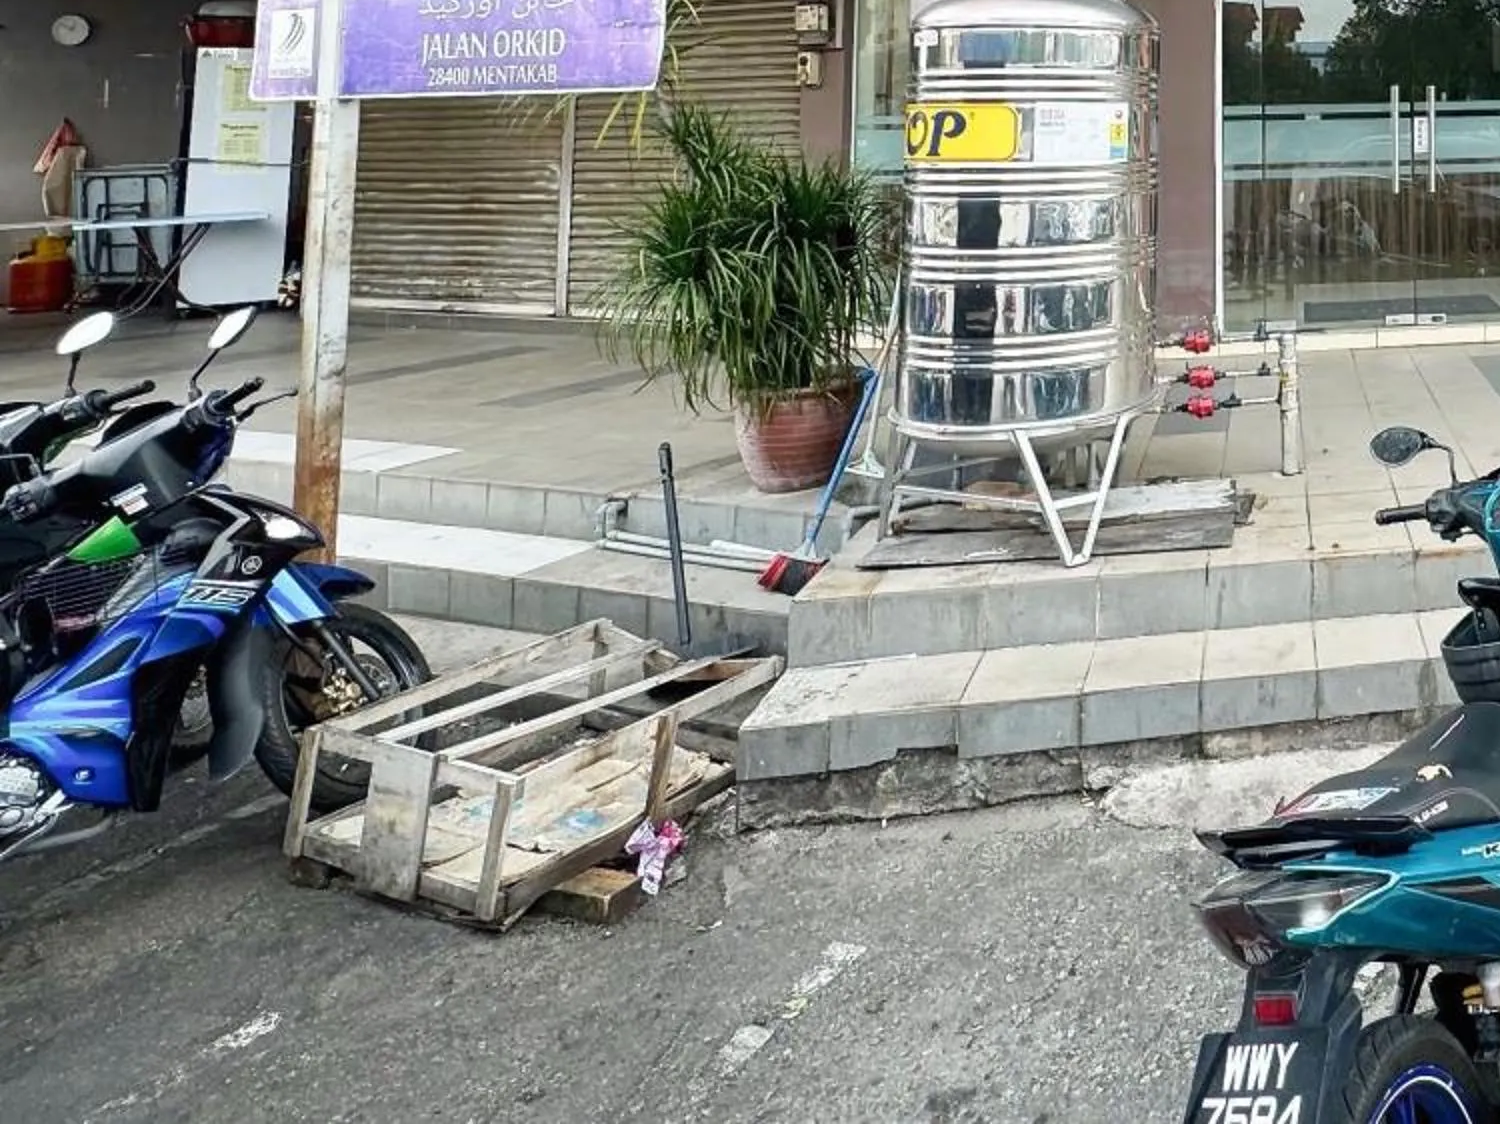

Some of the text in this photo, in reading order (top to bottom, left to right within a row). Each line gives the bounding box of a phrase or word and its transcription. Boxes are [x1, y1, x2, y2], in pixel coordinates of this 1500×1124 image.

[423, 27, 566, 67] JALAN ORKID
[428, 63, 558, 87] 28400 MENTAKAB
[1223, 1041, 1299, 1092] WWY
